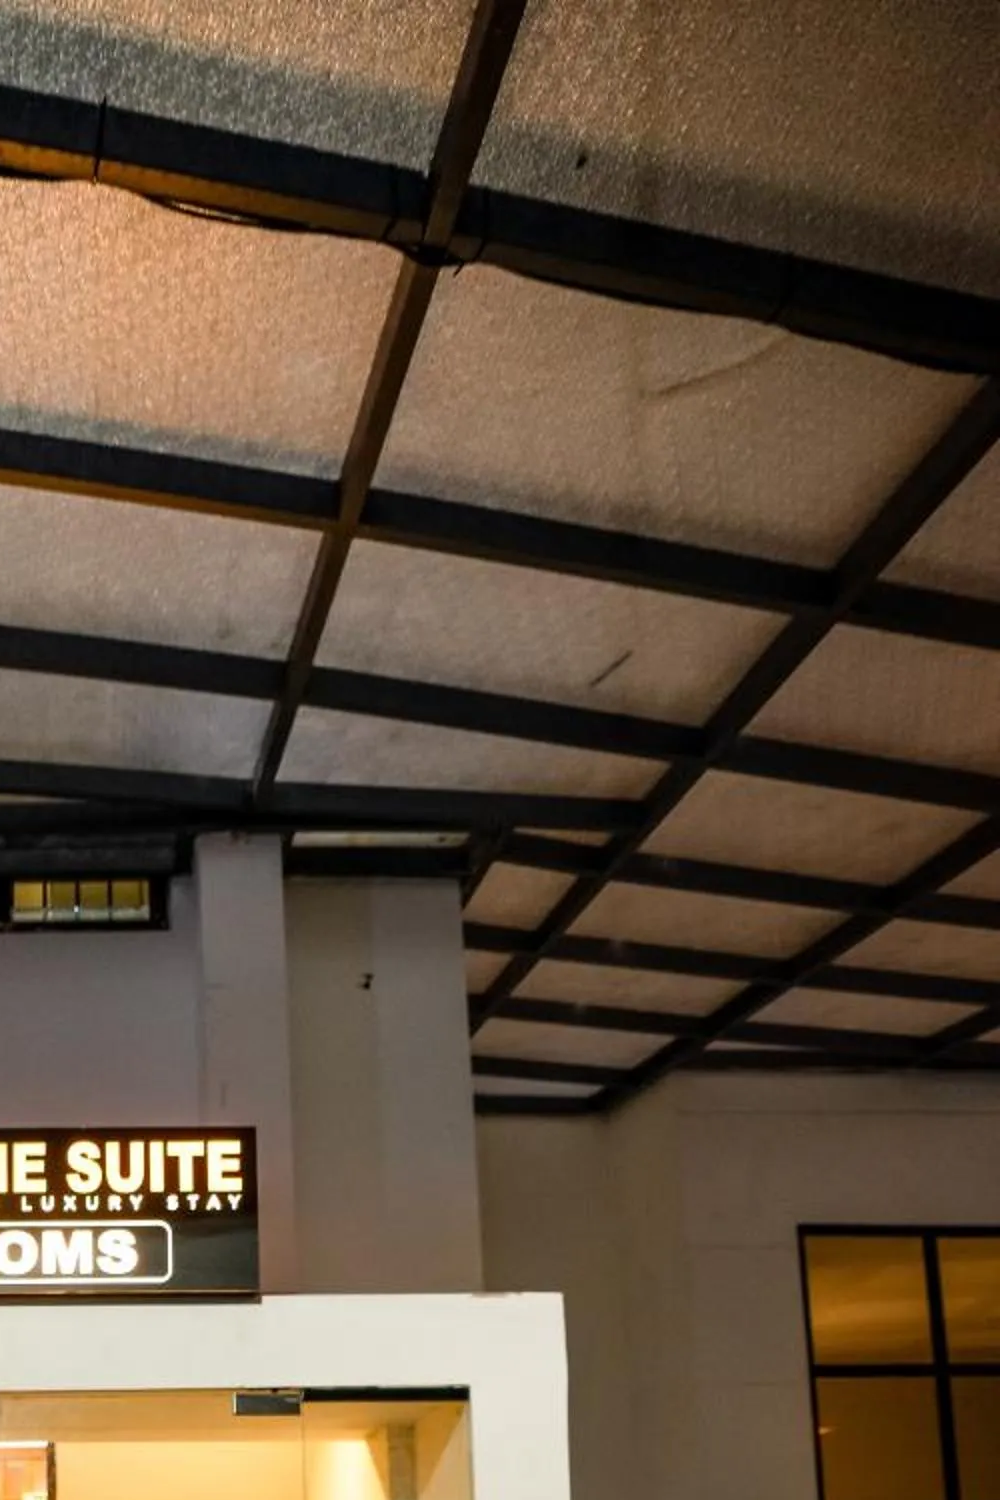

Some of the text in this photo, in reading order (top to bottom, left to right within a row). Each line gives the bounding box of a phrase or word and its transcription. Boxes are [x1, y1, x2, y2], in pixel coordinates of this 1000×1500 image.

[65, 1140, 243, 1194] SUITE
[20, 1195, 144, 1212] LUXURY
[166, 1194, 243, 1211] STAY
